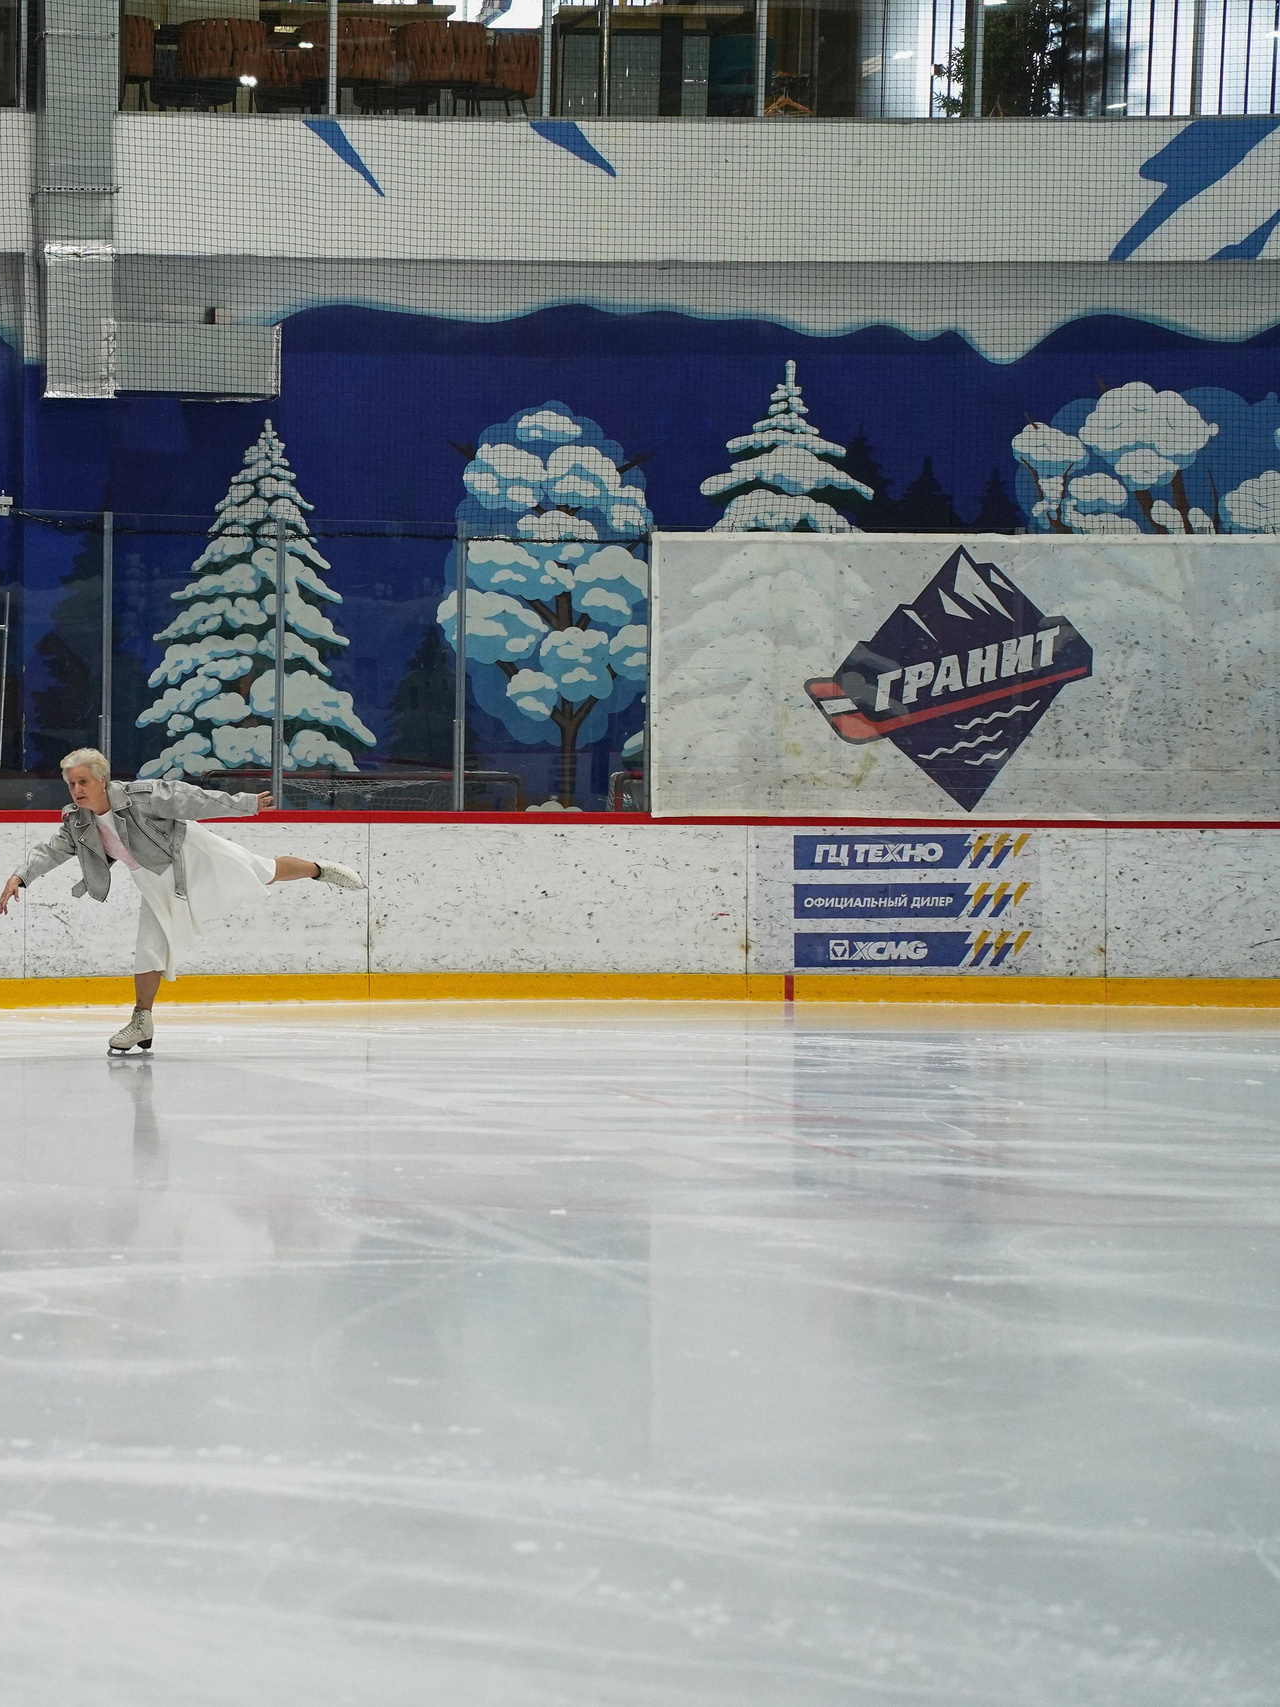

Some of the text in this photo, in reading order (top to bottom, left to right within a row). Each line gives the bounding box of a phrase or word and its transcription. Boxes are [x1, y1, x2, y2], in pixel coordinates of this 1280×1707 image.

[875, 626, 1060, 712] ГРАНИТ
[814, 842, 944, 866] ГЦ ТЕХНО
[804, 894, 954, 909] ОФИЦИАЛЬНЫЙ ДИЛЕР
[849, 941, 928, 960] XCMG
